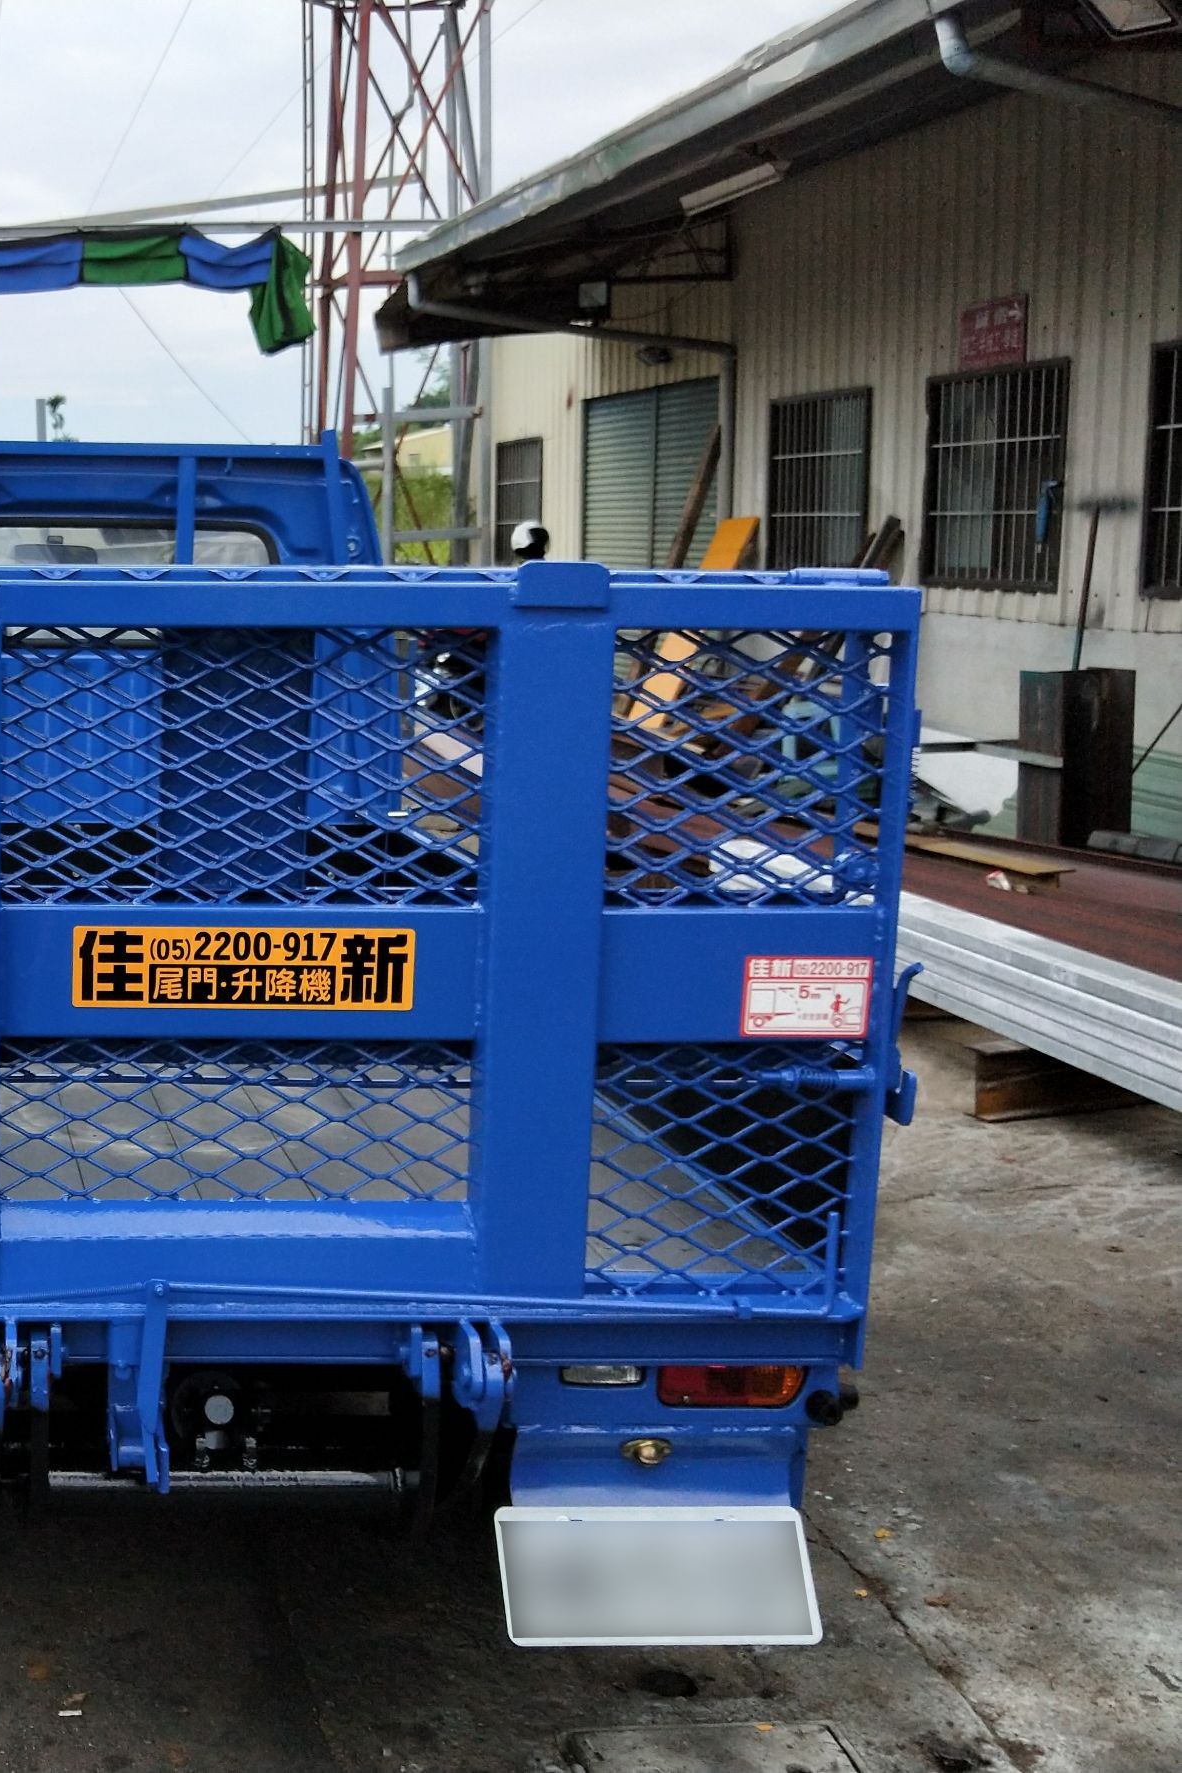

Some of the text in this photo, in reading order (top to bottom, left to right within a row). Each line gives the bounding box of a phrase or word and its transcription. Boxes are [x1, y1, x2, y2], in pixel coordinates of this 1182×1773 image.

[78, 930, 144, 1001] 佳
[149, 931, 338, 963] (05)2200-917
[340, 933, 409, 1004] 新
